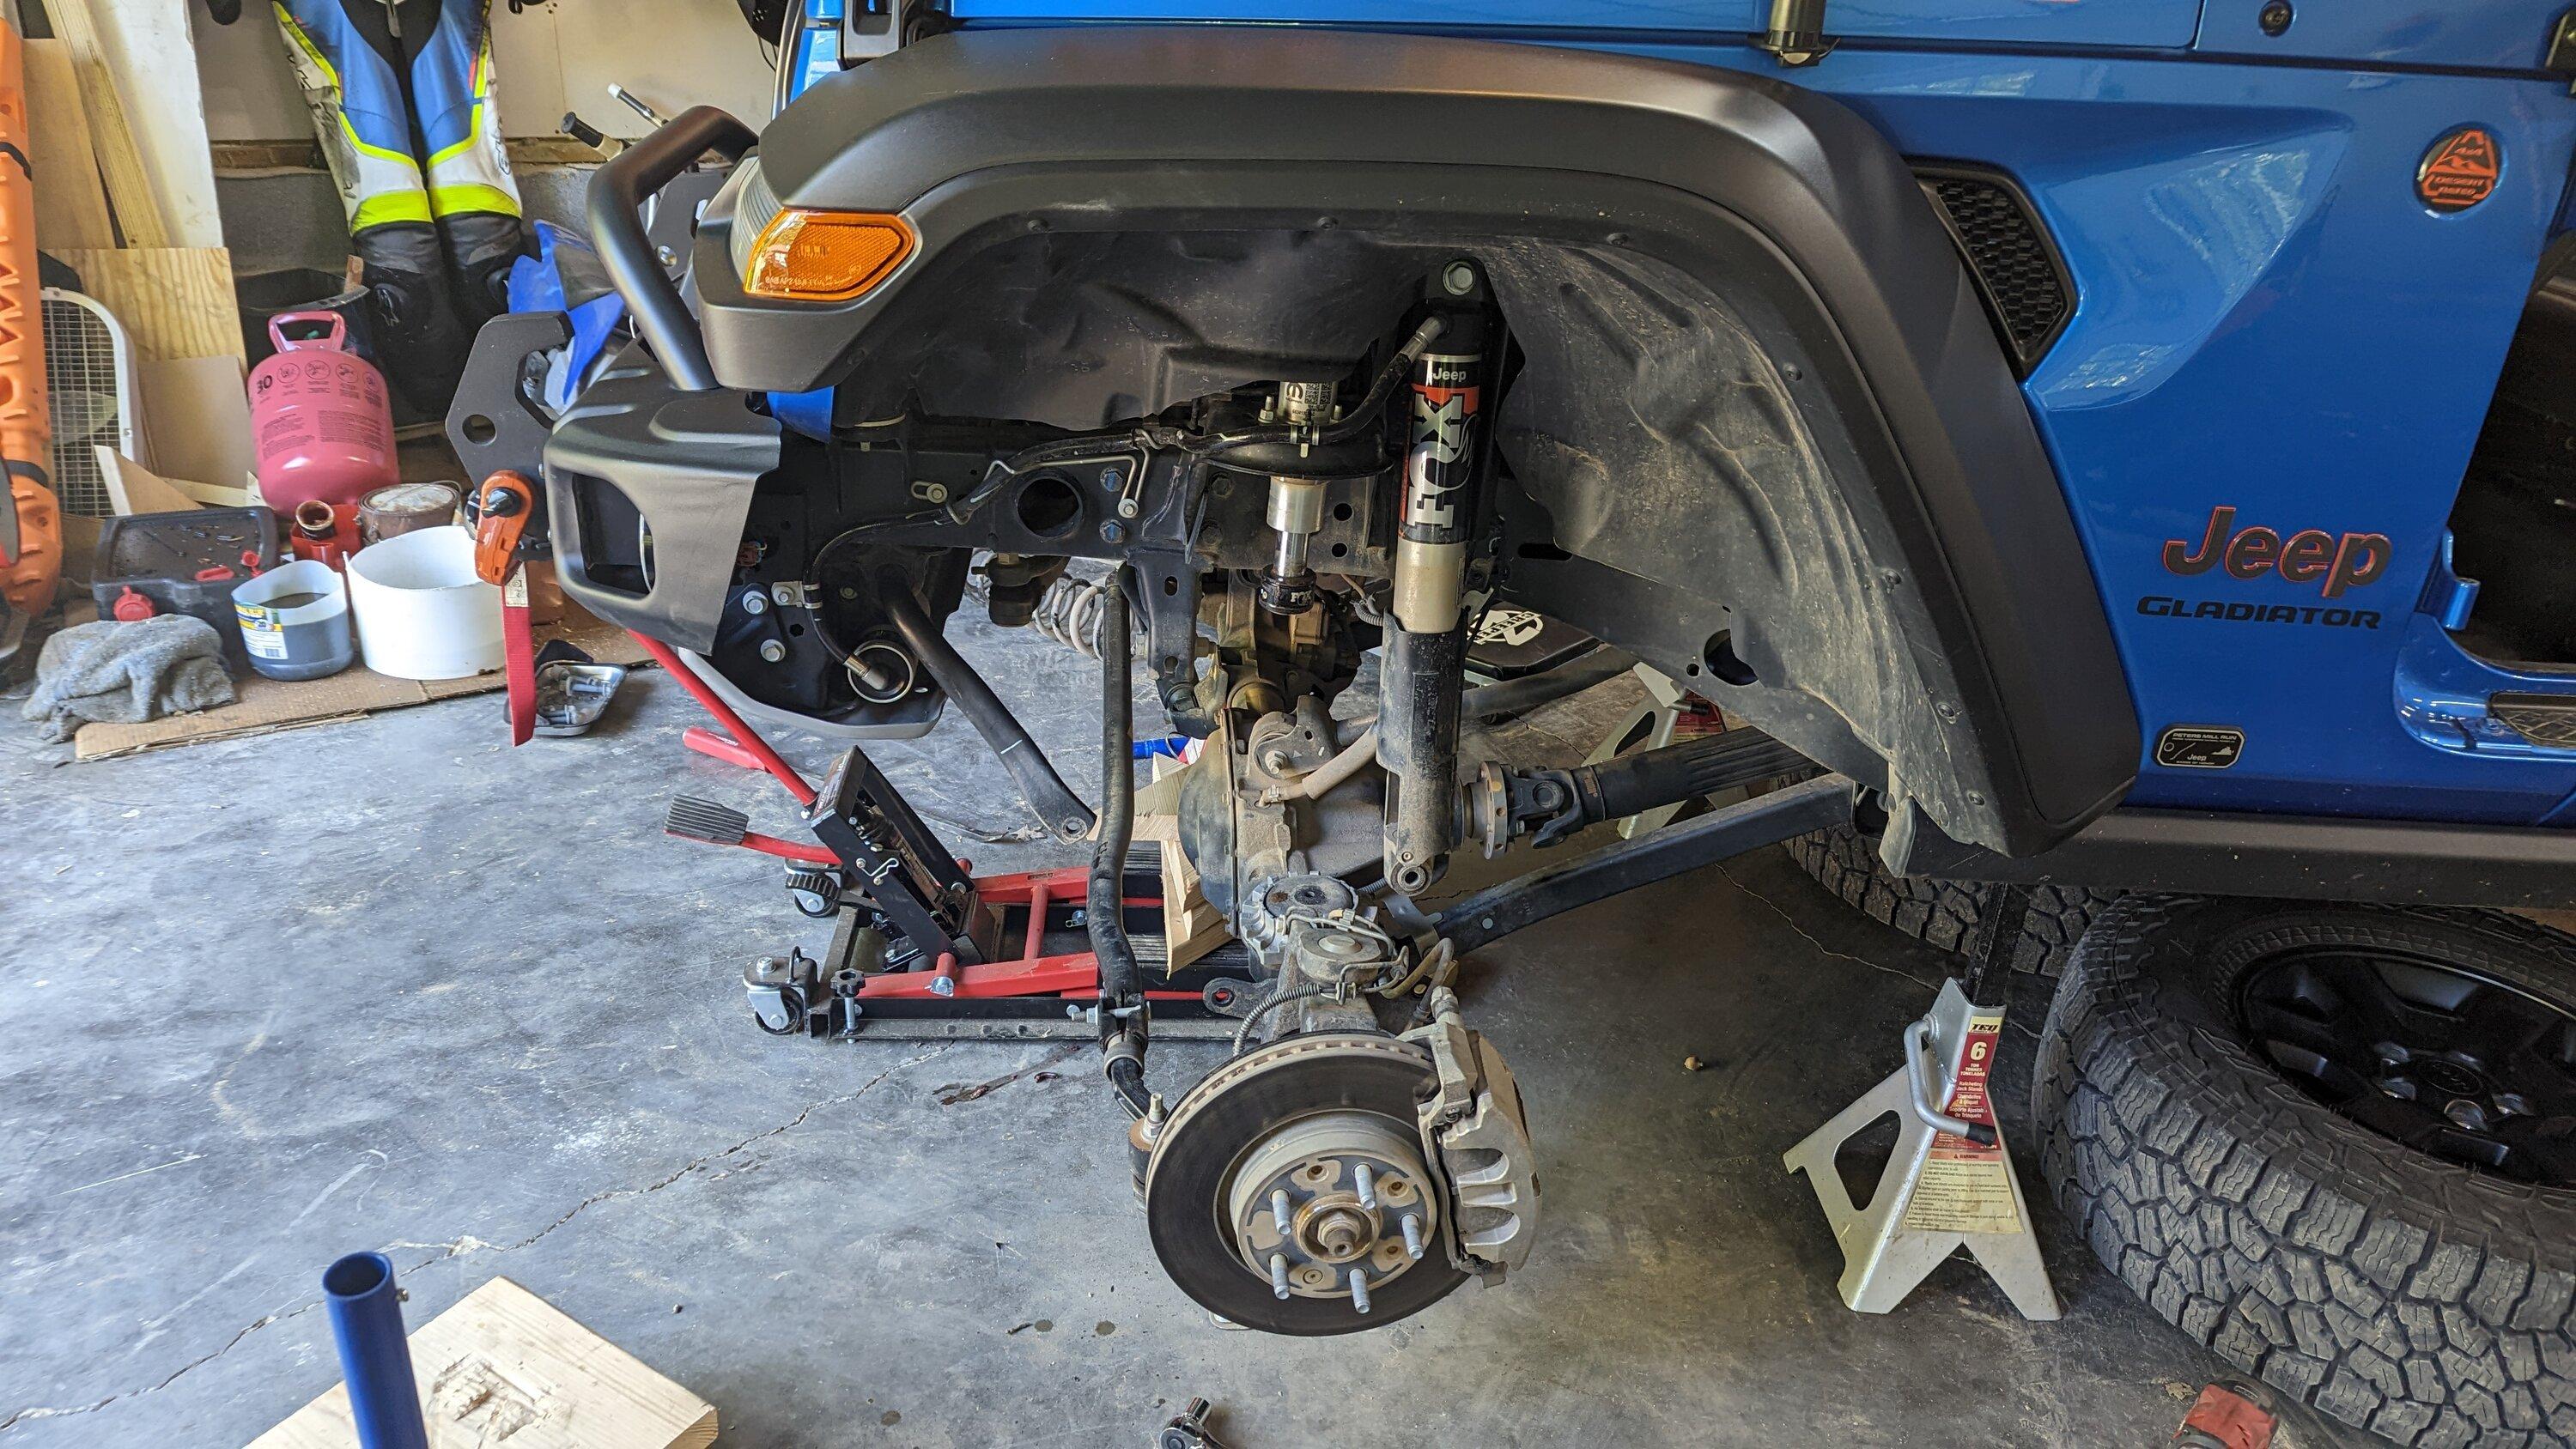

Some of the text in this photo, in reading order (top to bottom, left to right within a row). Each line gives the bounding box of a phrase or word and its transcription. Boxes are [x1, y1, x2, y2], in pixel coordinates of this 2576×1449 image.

[1432, 367, 1467, 383] Jeep
[1406, 393, 1477, 529] FOX
[2162, 505, 2392, 598] Jeep
[2136, 596, 2381, 629] GLADIATOR
[1970, 1041, 1988, 1061] 6
